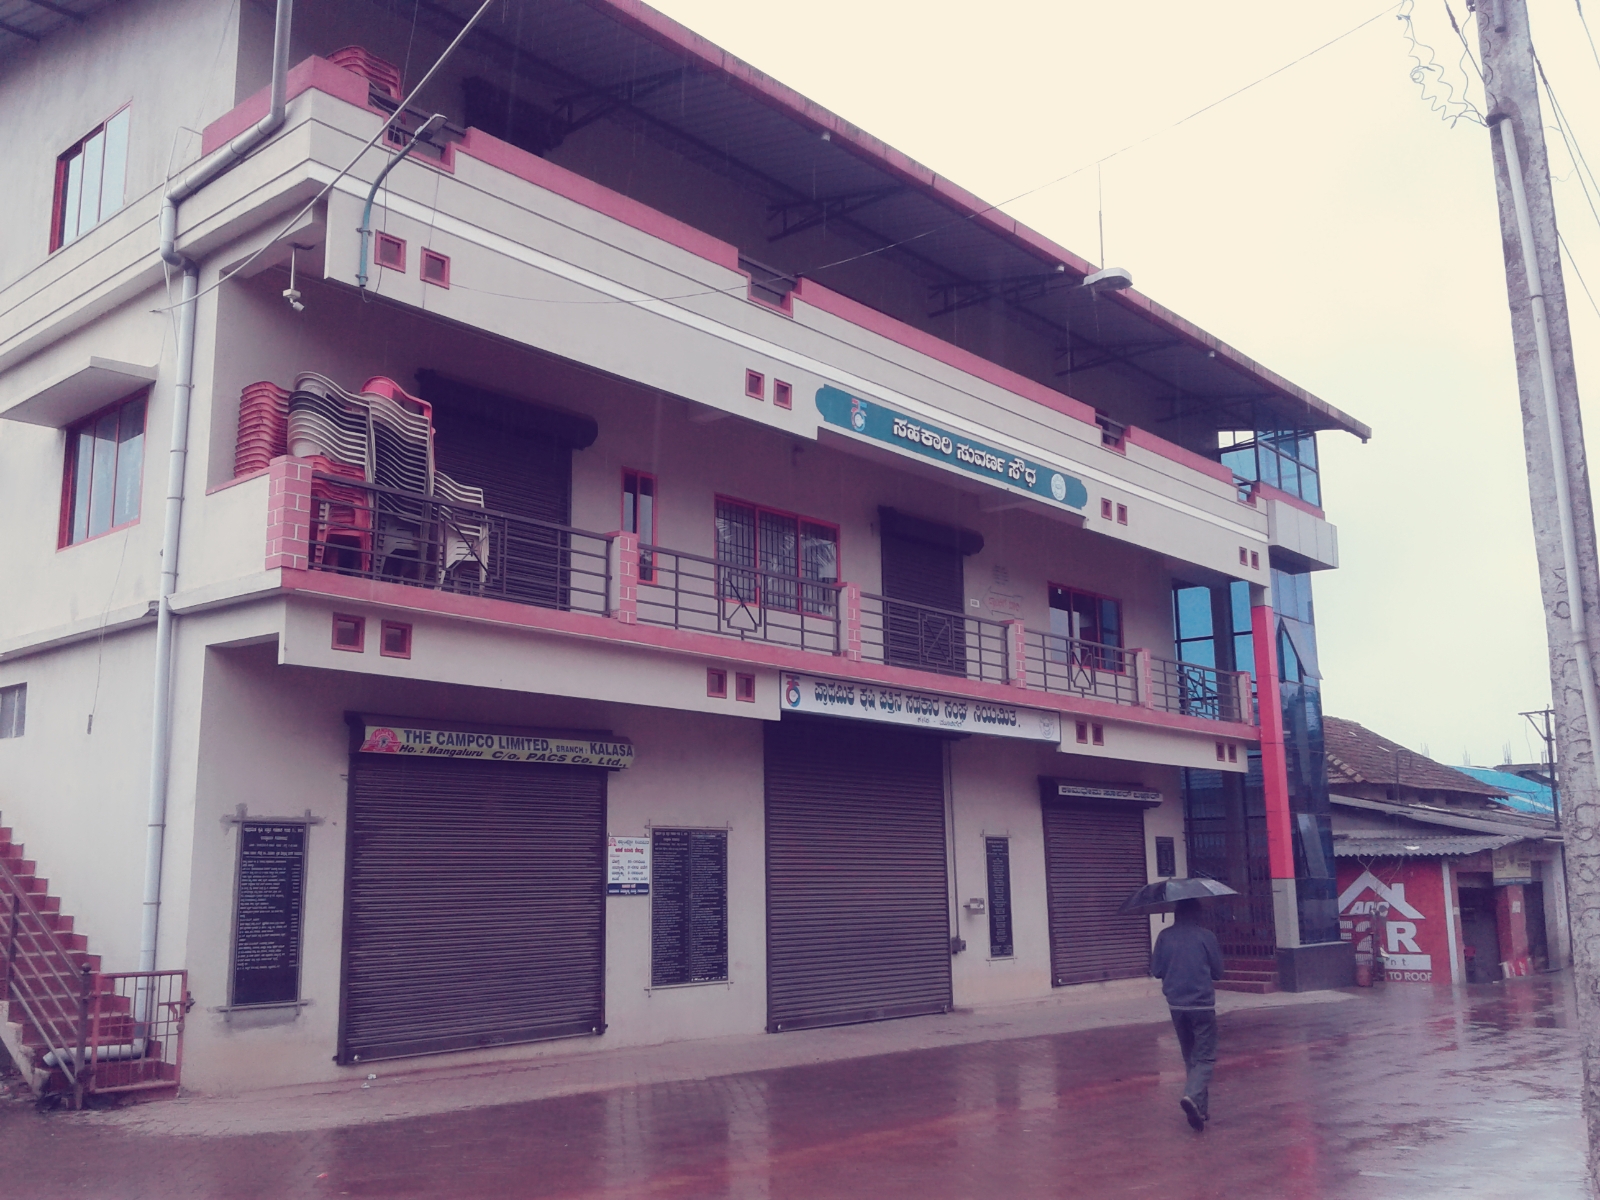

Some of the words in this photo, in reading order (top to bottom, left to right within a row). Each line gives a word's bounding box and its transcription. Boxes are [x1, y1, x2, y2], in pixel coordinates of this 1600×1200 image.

[893, 418, 953, 454] ಸಹಕಾರಿ
[956, 443, 1006, 473] ಸುವರ್ಣ
[1008, 457, 1037, 487] ಸೌಧ
[814, 682, 855, 706] ಪ್ರಾಥಮಿಕ
[860, 687, 876, 711] ಕೃಷಿ
[879, 689, 902, 714] ಪತ್ತಿನ
[905, 694, 939, 716] ಸಹಕಾರ
[944, 701, 968, 720] ಸಂಘ
[404, 730, 432, 744] THE
[436, 732, 494, 746] CAMPCO
[499, 737, 553, 753] LIMITED,
[589, 743, 634, 757] KALASA
[426, 746, 483, 757] Mangaluru
[526, 753, 567, 762] PACS
[571, 755, 593, 764] Co.
[1389, 972, 1402, 981] TO
[1404, 972, 1432, 982] ROOF
